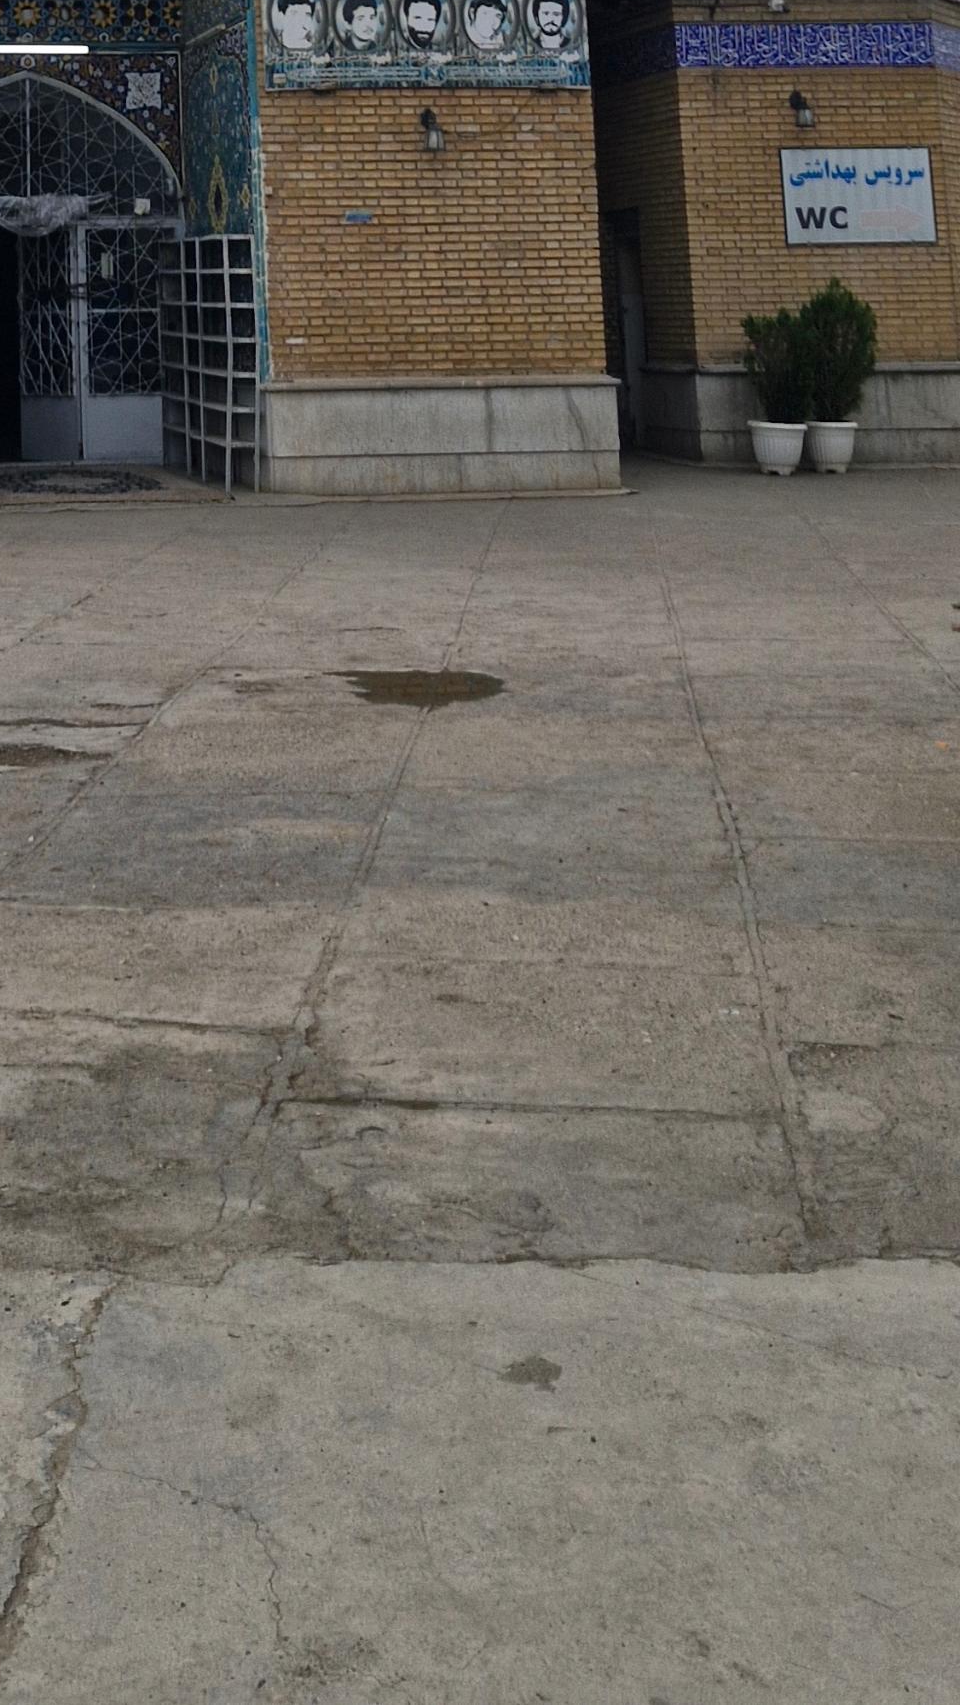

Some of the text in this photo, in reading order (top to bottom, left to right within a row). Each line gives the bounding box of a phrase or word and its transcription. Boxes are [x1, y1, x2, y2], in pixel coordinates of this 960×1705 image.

[789, 158, 925, 187] سرویس بهداشتی
[795, 206, 849, 230] WC
